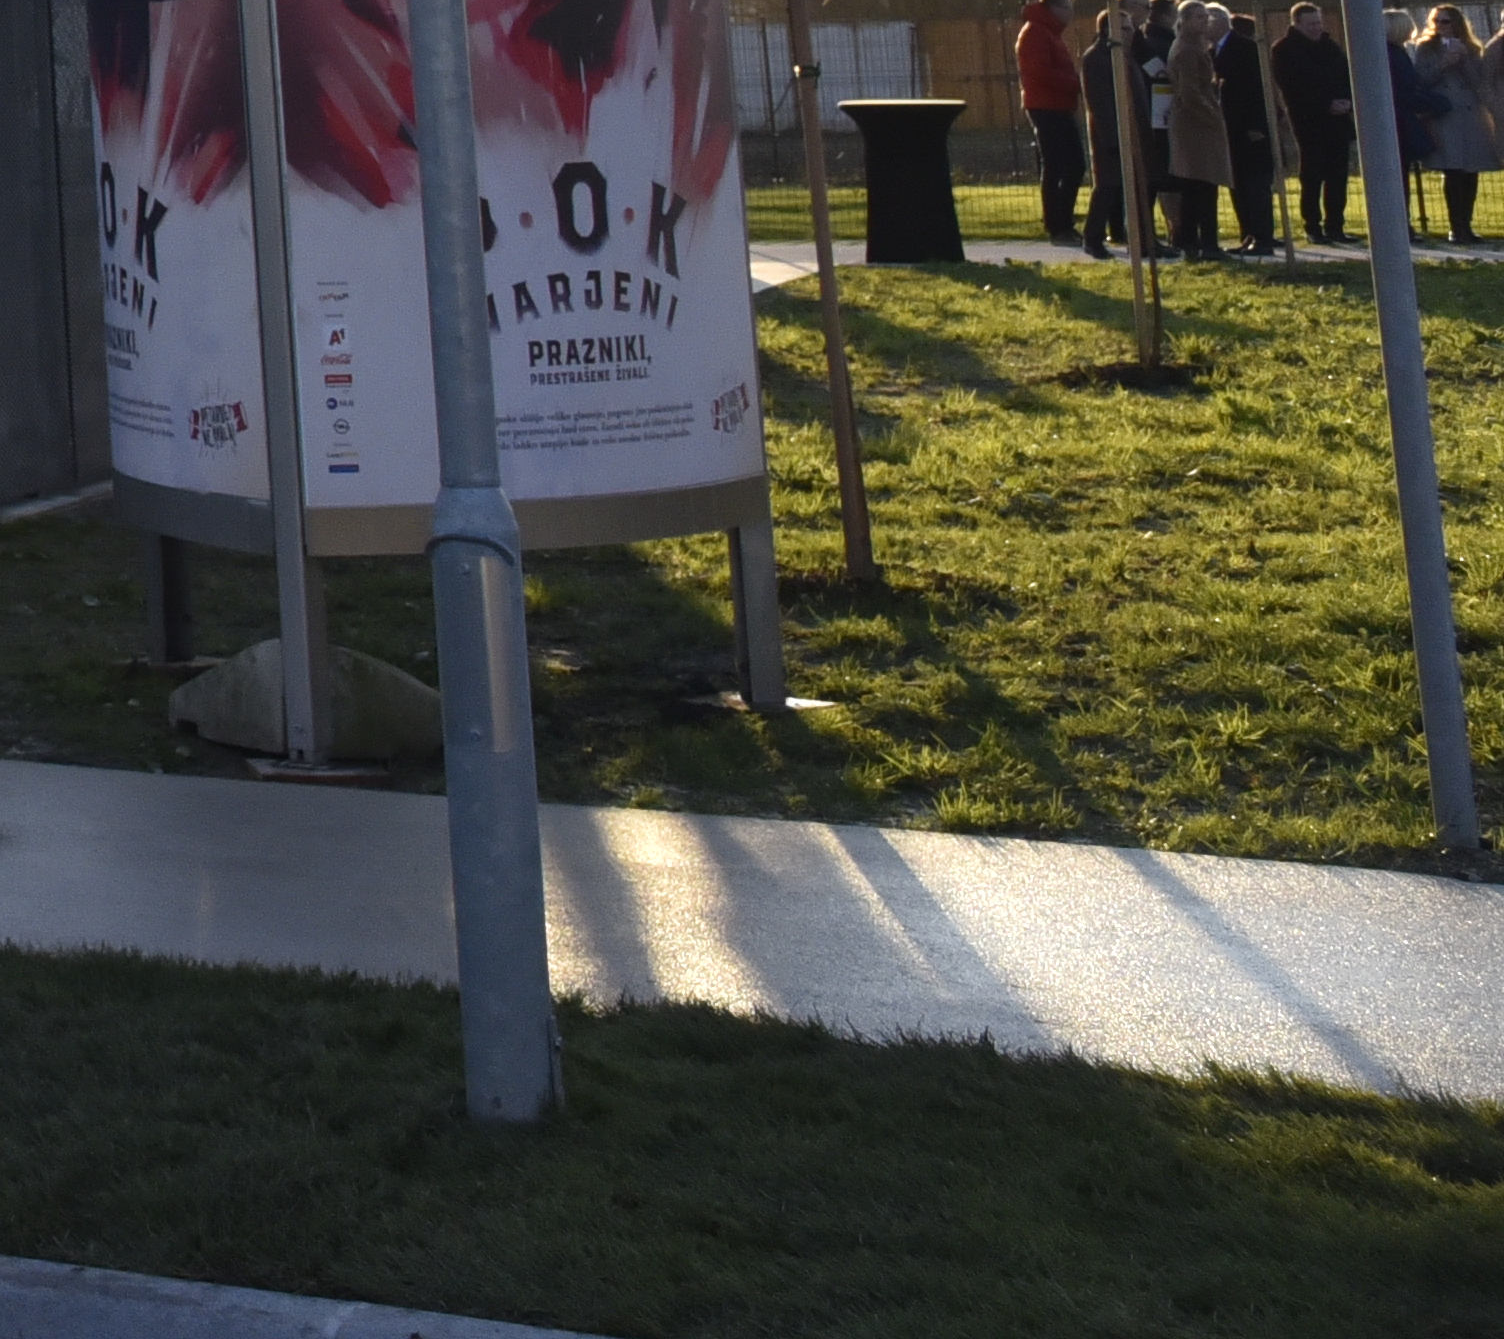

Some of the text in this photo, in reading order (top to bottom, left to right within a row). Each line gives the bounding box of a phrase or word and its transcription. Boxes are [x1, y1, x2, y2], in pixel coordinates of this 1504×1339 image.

[486, 270, 678, 332] ARJENI
[528, 334, 652, 367] PRAZNIKI,
[530, 366, 610, 386] PRESTRAŠENE
